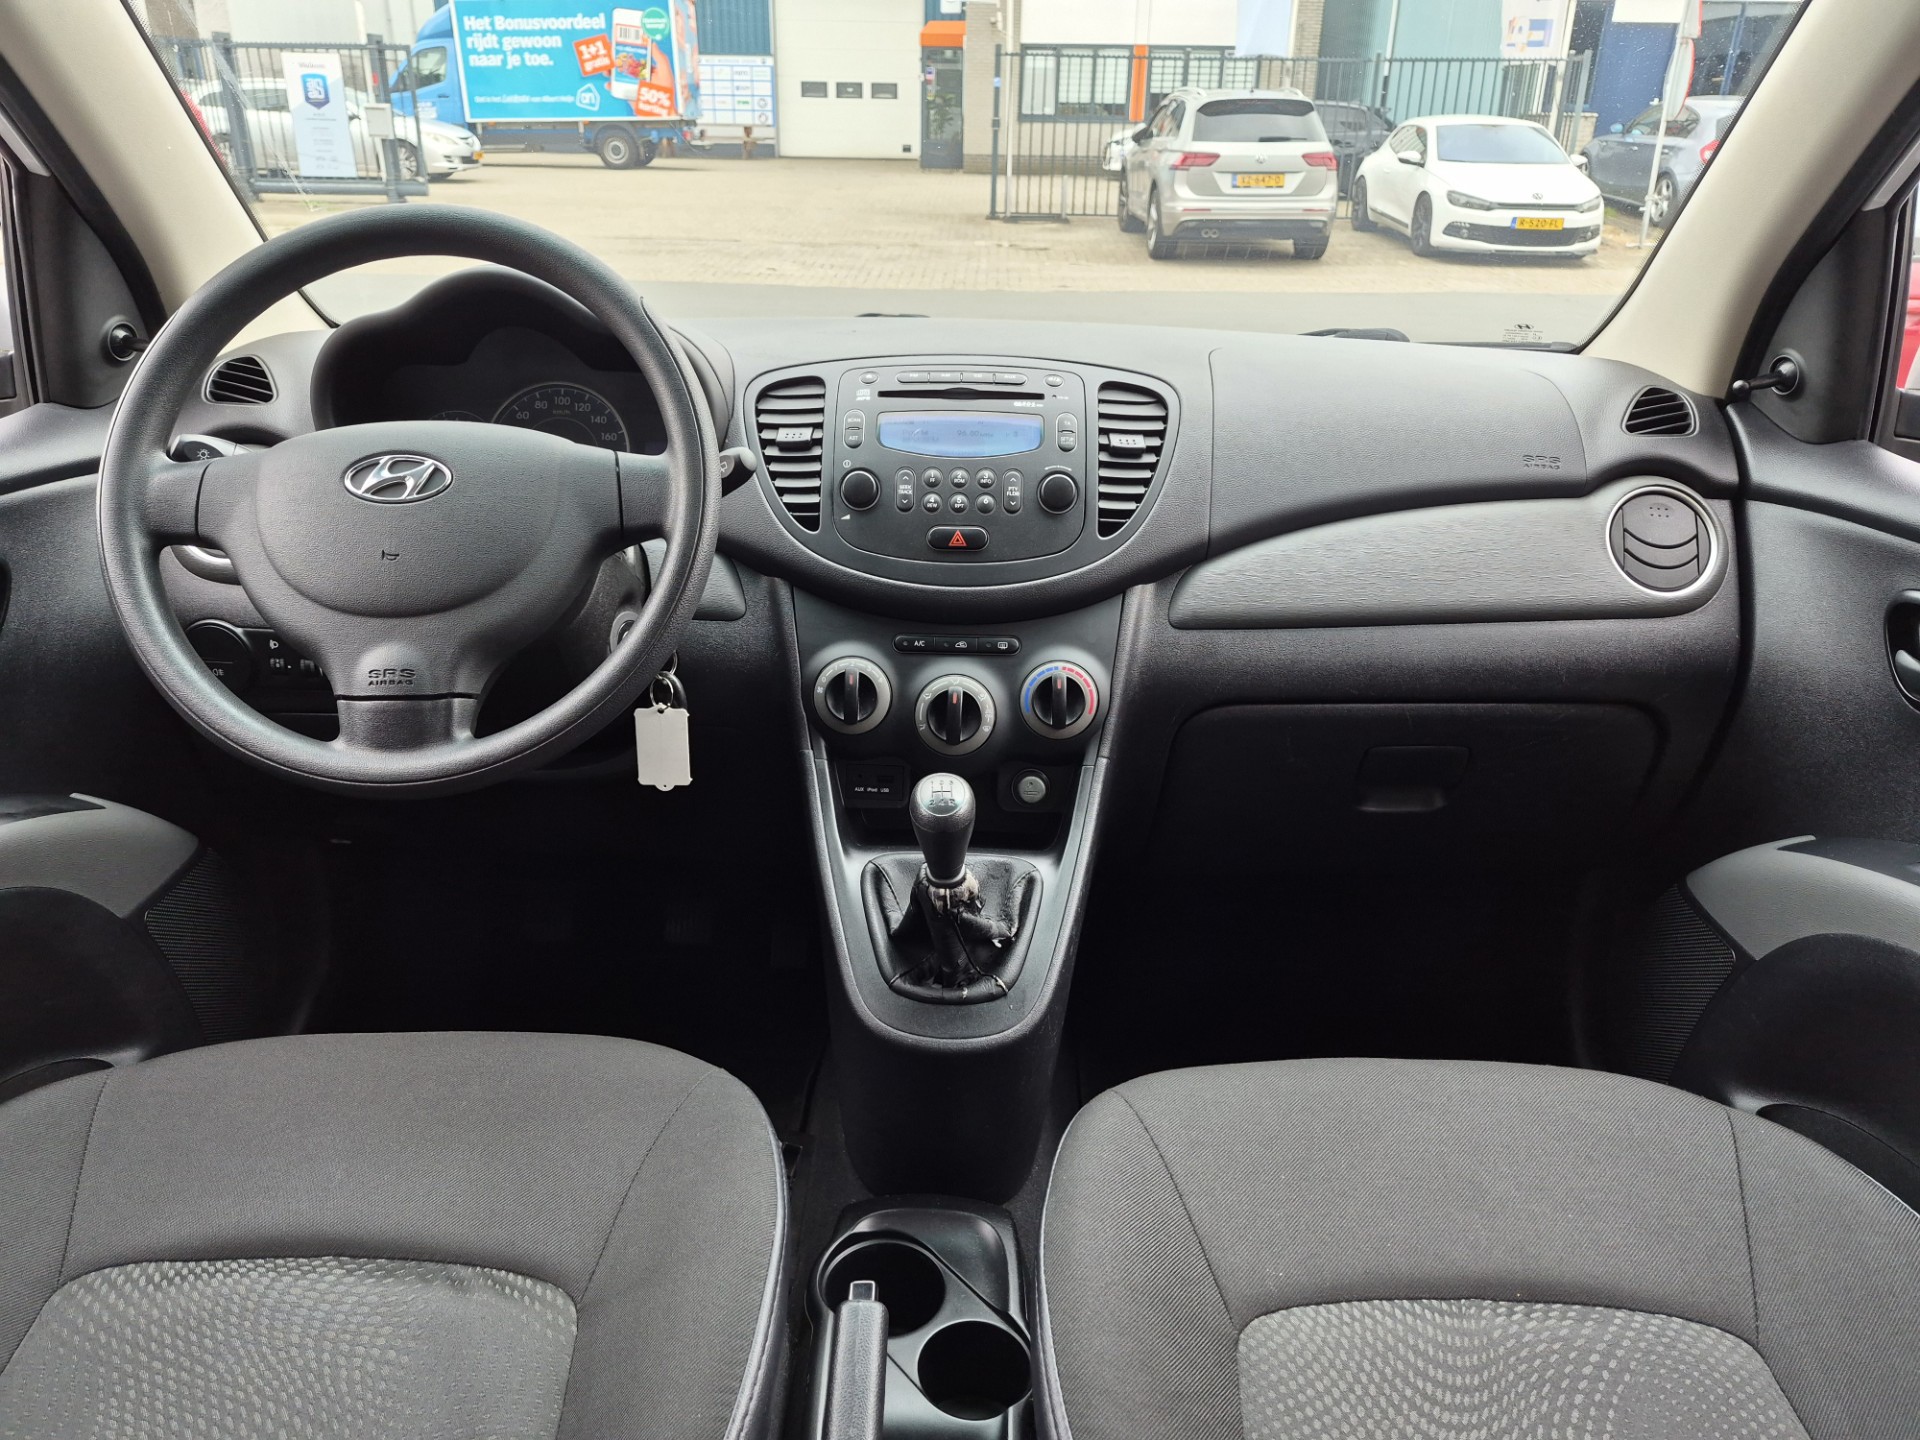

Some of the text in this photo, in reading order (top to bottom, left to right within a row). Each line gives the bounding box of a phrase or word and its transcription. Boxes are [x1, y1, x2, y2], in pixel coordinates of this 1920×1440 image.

[463, 12, 606, 30] Het Bonusvoordeel
[466, 33, 563, 52] rijdt gewoon
[578, 40, 608, 60] 1+1
[468, 51, 554, 70] naar je toe.
[639, 86, 671, 107] 50%
[534, 400, 548, 410] 80
[554, 396, 571, 406] 100
[574, 403, 591, 412] 120
[516, 411, 530, 420] 60
[590, 415, 608, 424] 140
[600, 432, 618, 441] 160
[368, 668, 416, 679] SRS
[928, 799, 936, 807] 2
